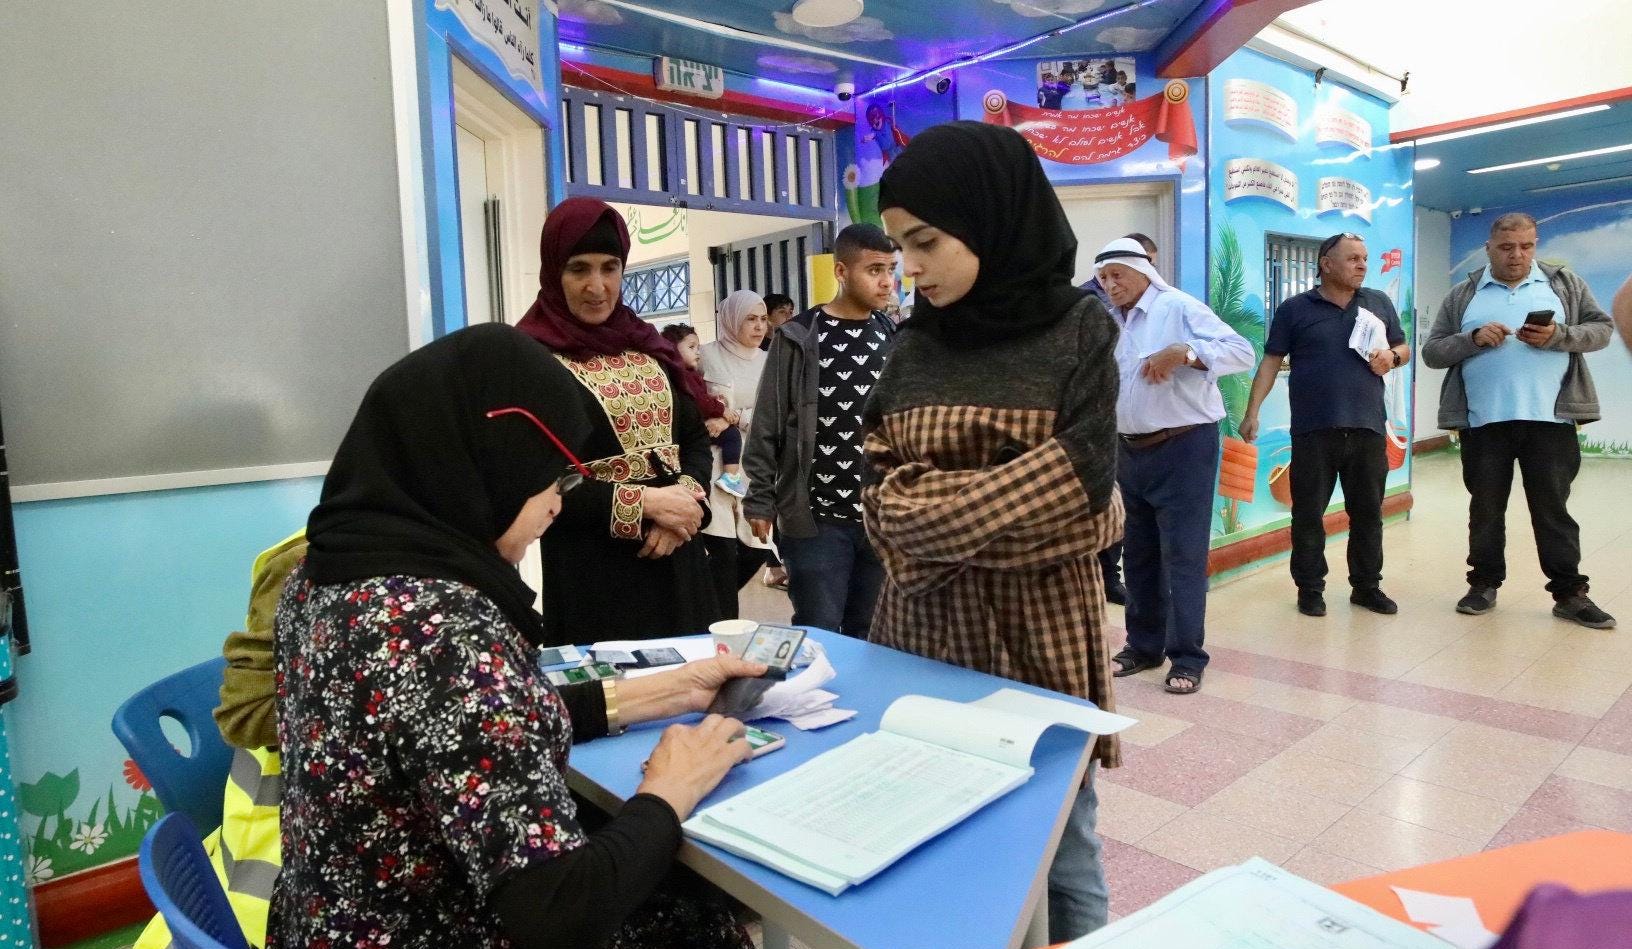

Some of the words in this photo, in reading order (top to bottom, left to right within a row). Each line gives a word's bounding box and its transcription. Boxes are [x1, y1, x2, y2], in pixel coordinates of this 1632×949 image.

[504, 30, 517, 49] الناس
[1041, 111, 1063, 119] אמרת
[1105, 106, 1126, 118] אנשים
[1110, 114, 1135, 130] אנשים
[1129, 121, 1146, 135] אבל
[1081, 125, 1105, 133] ישכחו
[1052, 136, 1069, 144] לא
[1068, 136, 1097, 146] לעולם
[1097, 132, 1123, 146] אנשים
[1072, 152, 1095, 161] להם
[1096, 147, 1122, 160] גרמת
